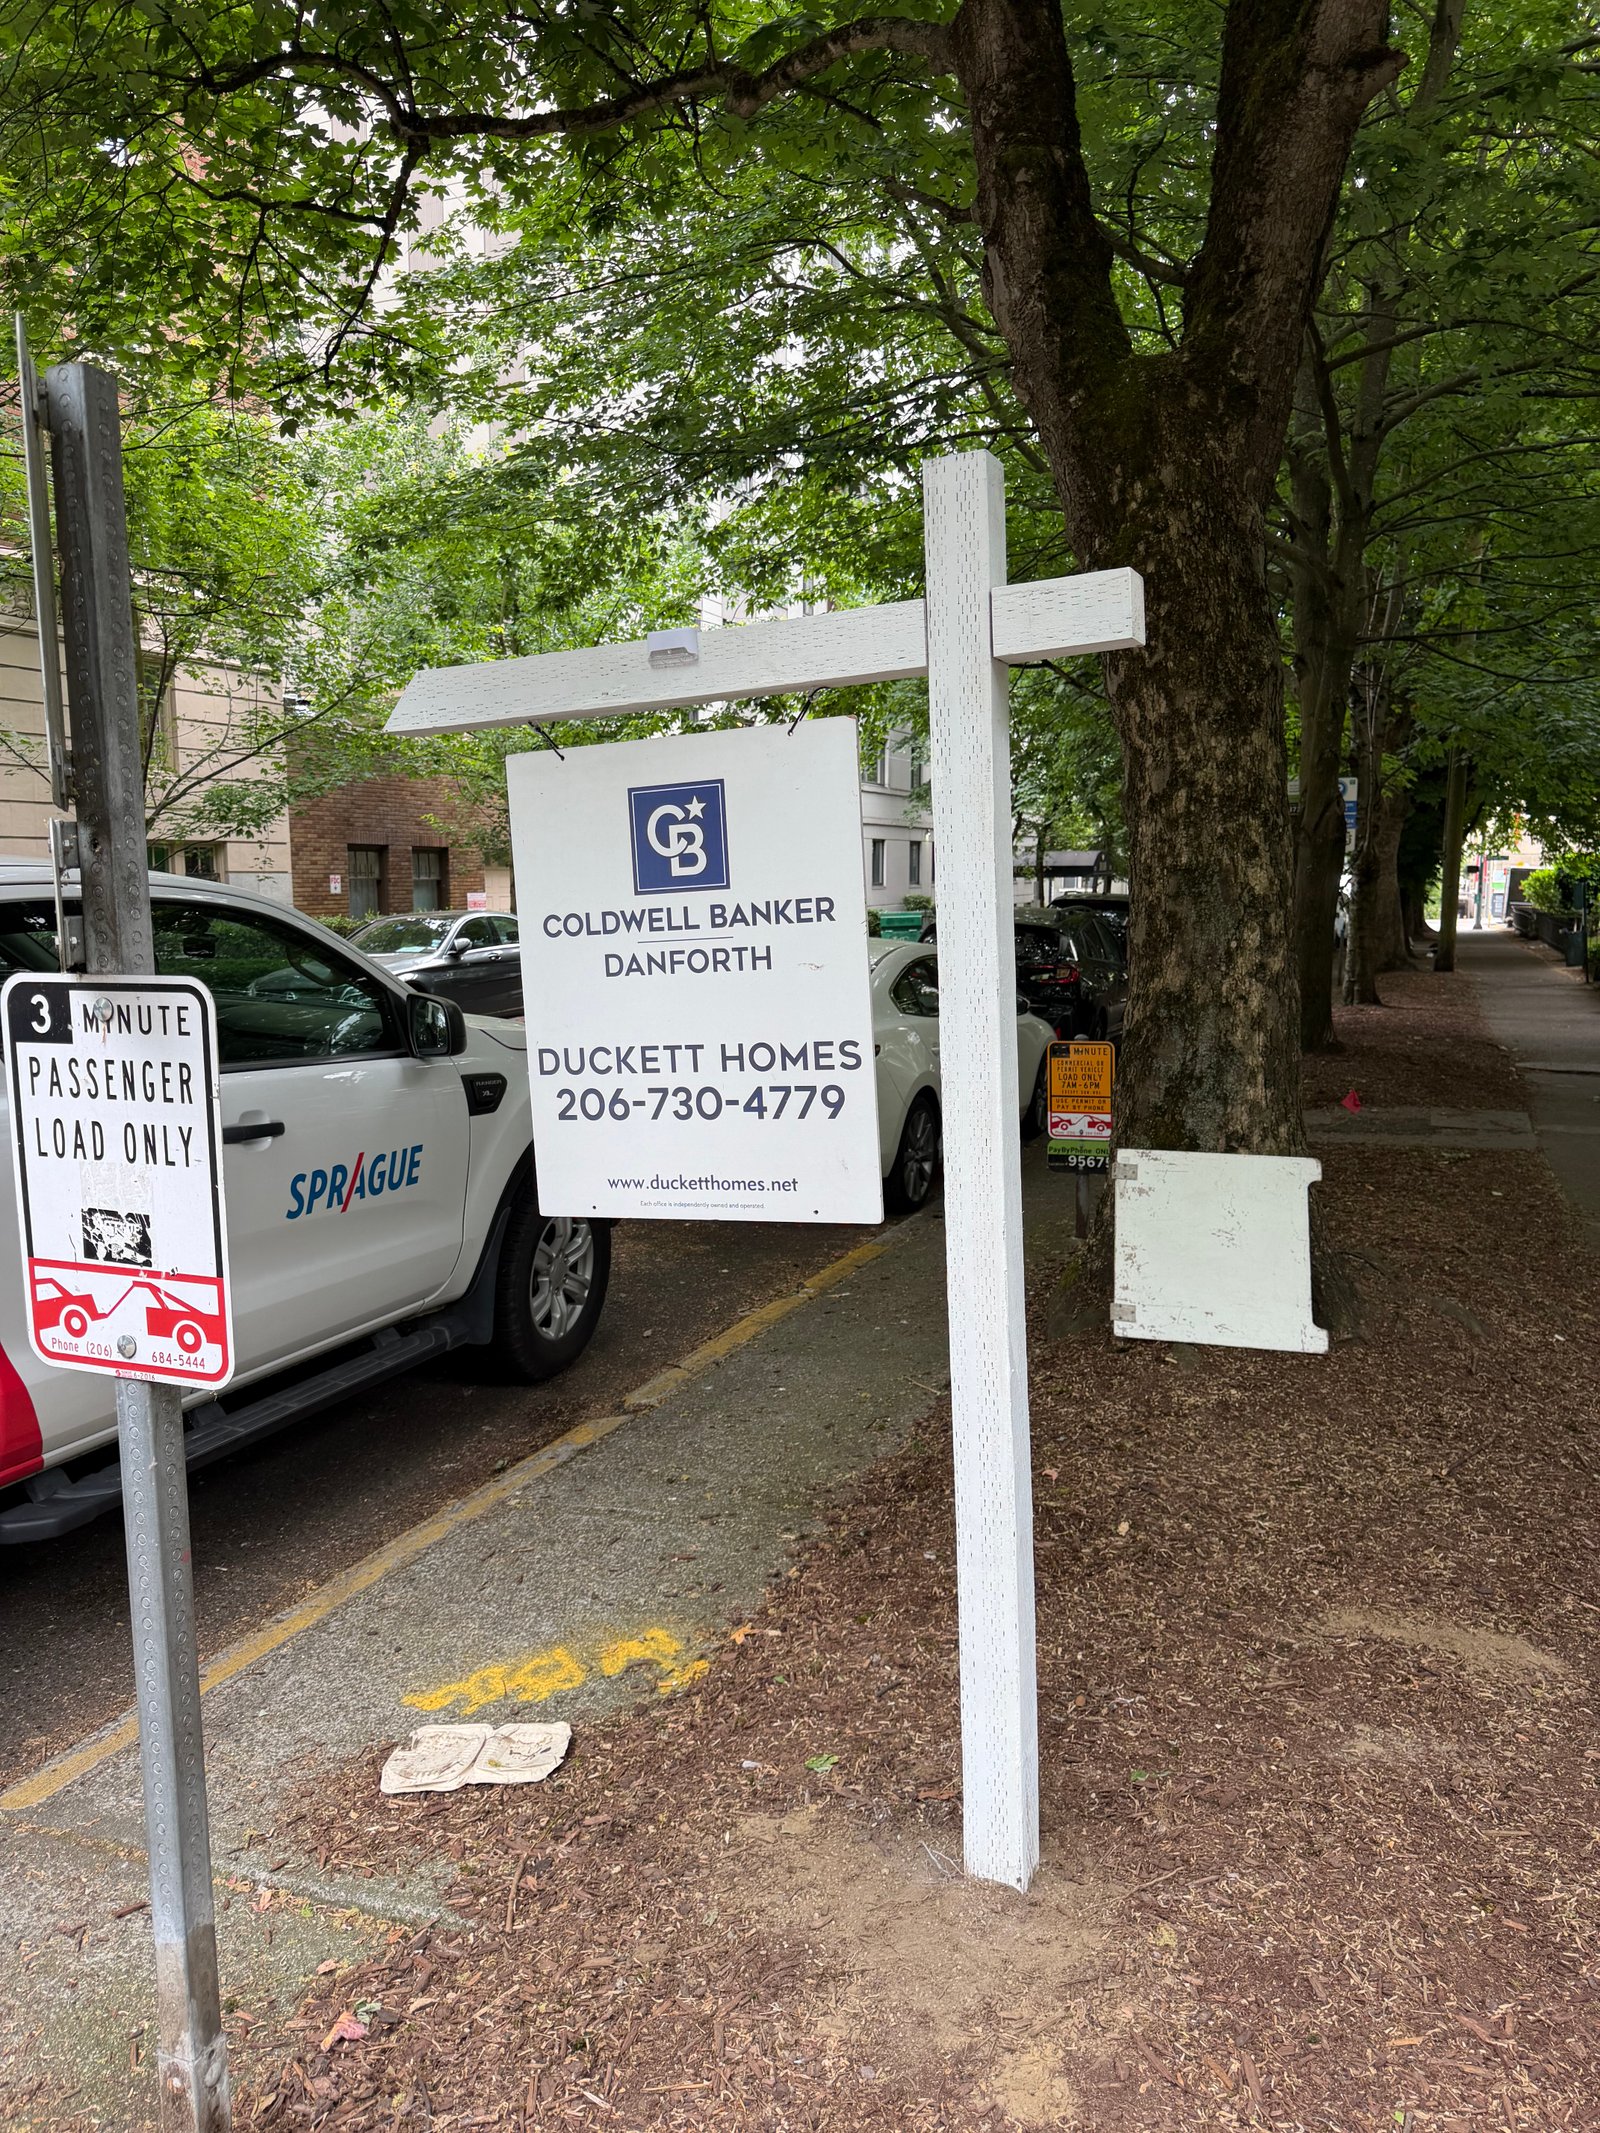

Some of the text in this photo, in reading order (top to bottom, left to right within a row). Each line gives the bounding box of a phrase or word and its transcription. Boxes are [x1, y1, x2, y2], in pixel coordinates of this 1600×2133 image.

[543, 896, 836, 939] COLDWELL BANKER
[604, 945, 773, 978] DANFORTH
[30, 994, 52, 1034] 3
[538, 1040, 862, 1076] DUCKETT HOMES
[28, 1056, 194, 1105] PASSENGER
[1061, 1081, 1077, 1089] 7AM
[1081, 1073, 1103, 1081] ONLY
[556, 1084, 846, 1121] 206-730-4779
[35, 1117, 193, 1168] LOAD ONLY
[1049, 1146, 1092, 1154] PayByPhone
[285, 1144, 424, 1220] SPRAGUE
[607, 1174, 799, 1192] www.ducketthomes.net
[673, 1201, 709, 1209] independently
[51, 1337, 206, 1369] Phone (206) 684-5444
